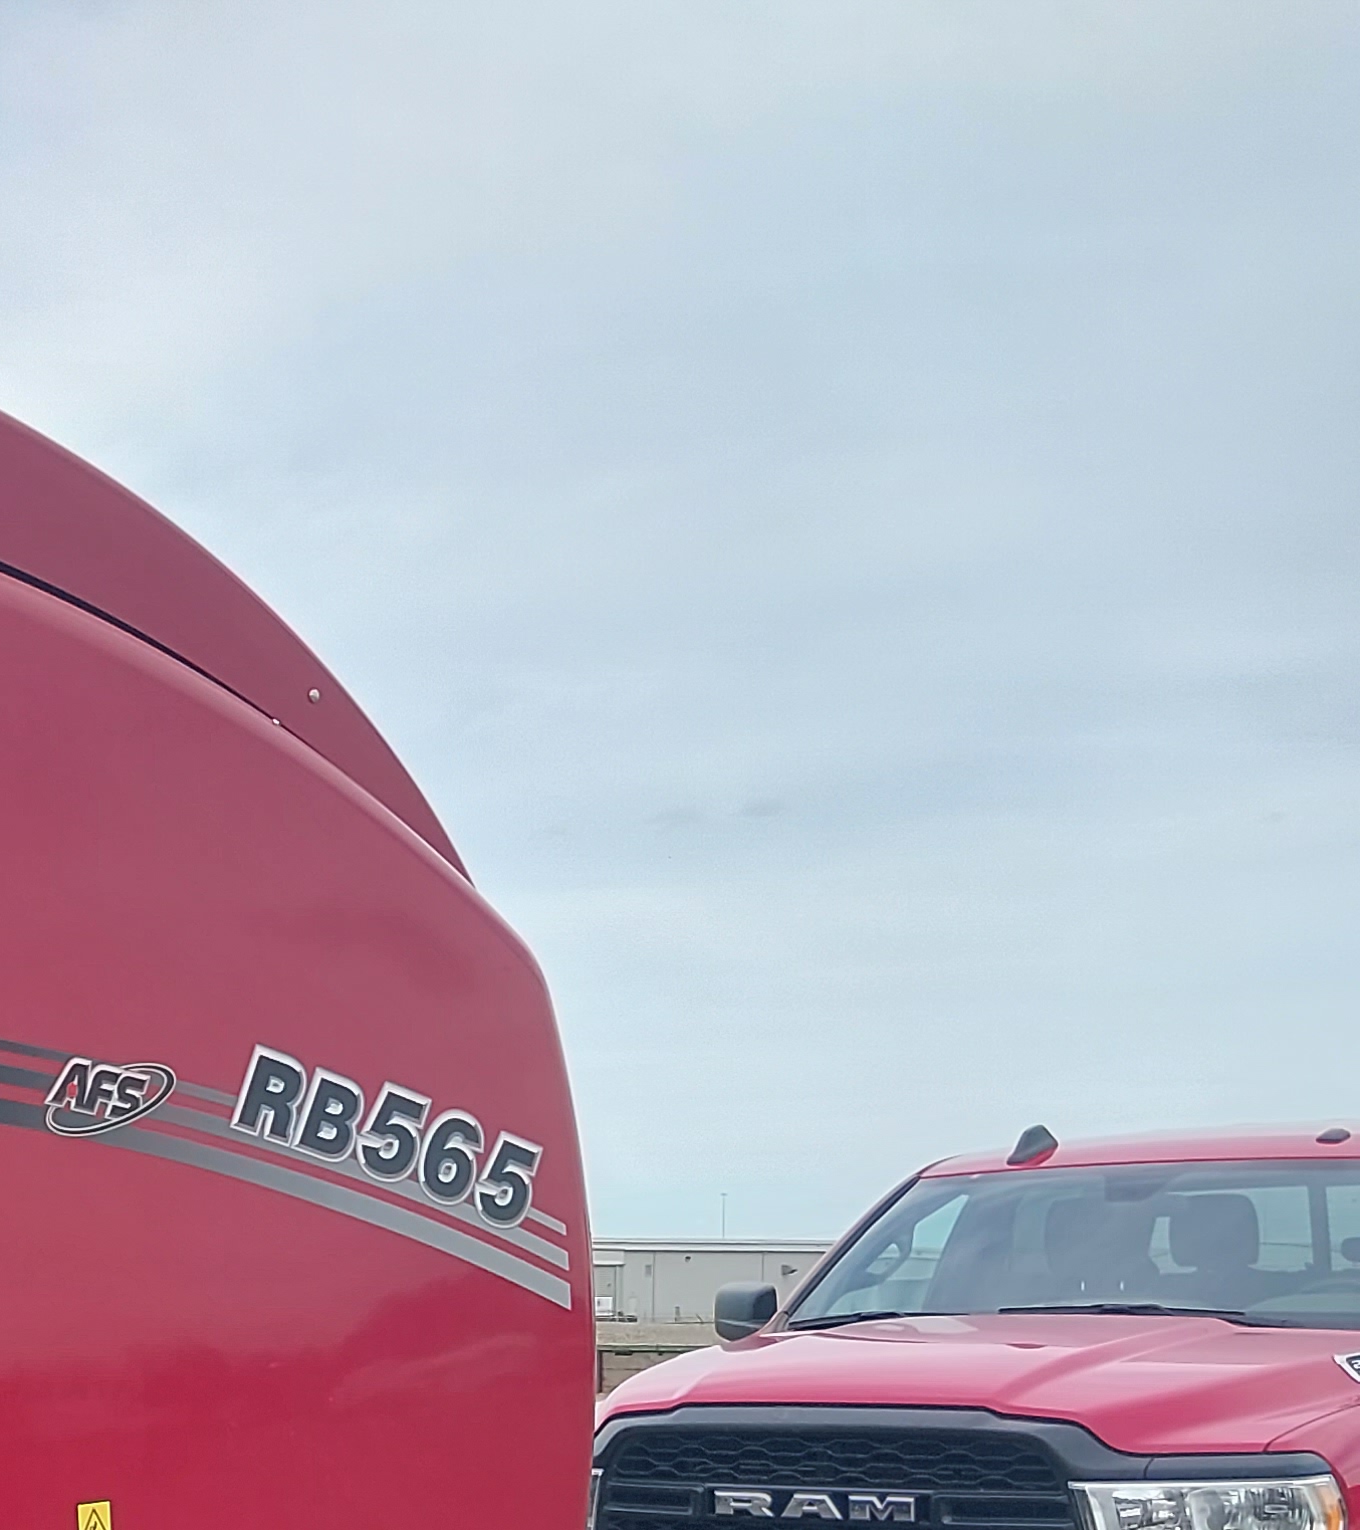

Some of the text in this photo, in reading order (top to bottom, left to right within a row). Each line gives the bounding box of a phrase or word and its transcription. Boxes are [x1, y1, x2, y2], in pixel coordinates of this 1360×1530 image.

[44, 1057, 151, 1121] AFS
[230, 1043, 543, 1229] RB565
[713, 1489, 916, 1523] RAM
